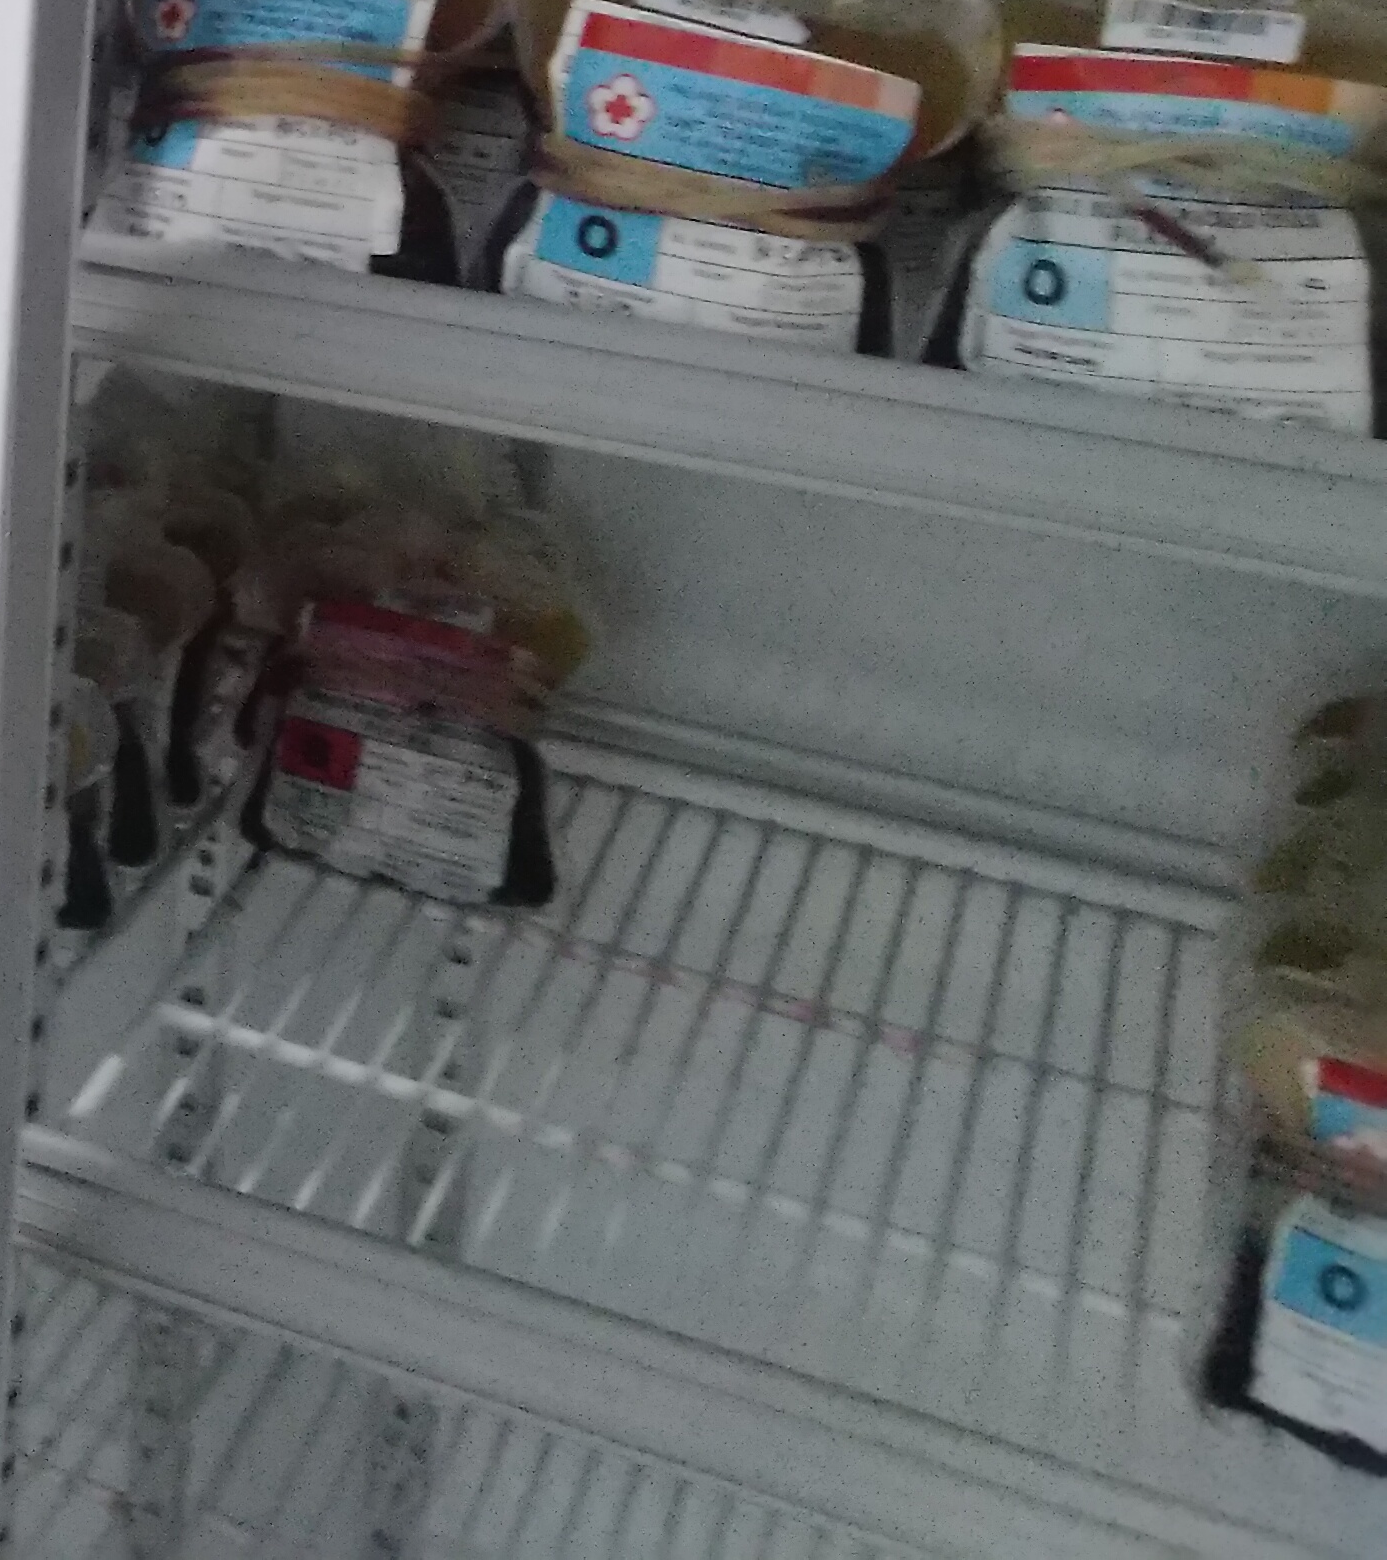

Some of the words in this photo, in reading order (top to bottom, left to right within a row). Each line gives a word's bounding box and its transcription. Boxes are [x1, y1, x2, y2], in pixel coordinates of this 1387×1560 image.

[575, 215, 618, 258] O
[1023, 258, 1067, 306] O
[1319, 1265, 1366, 1311] O
